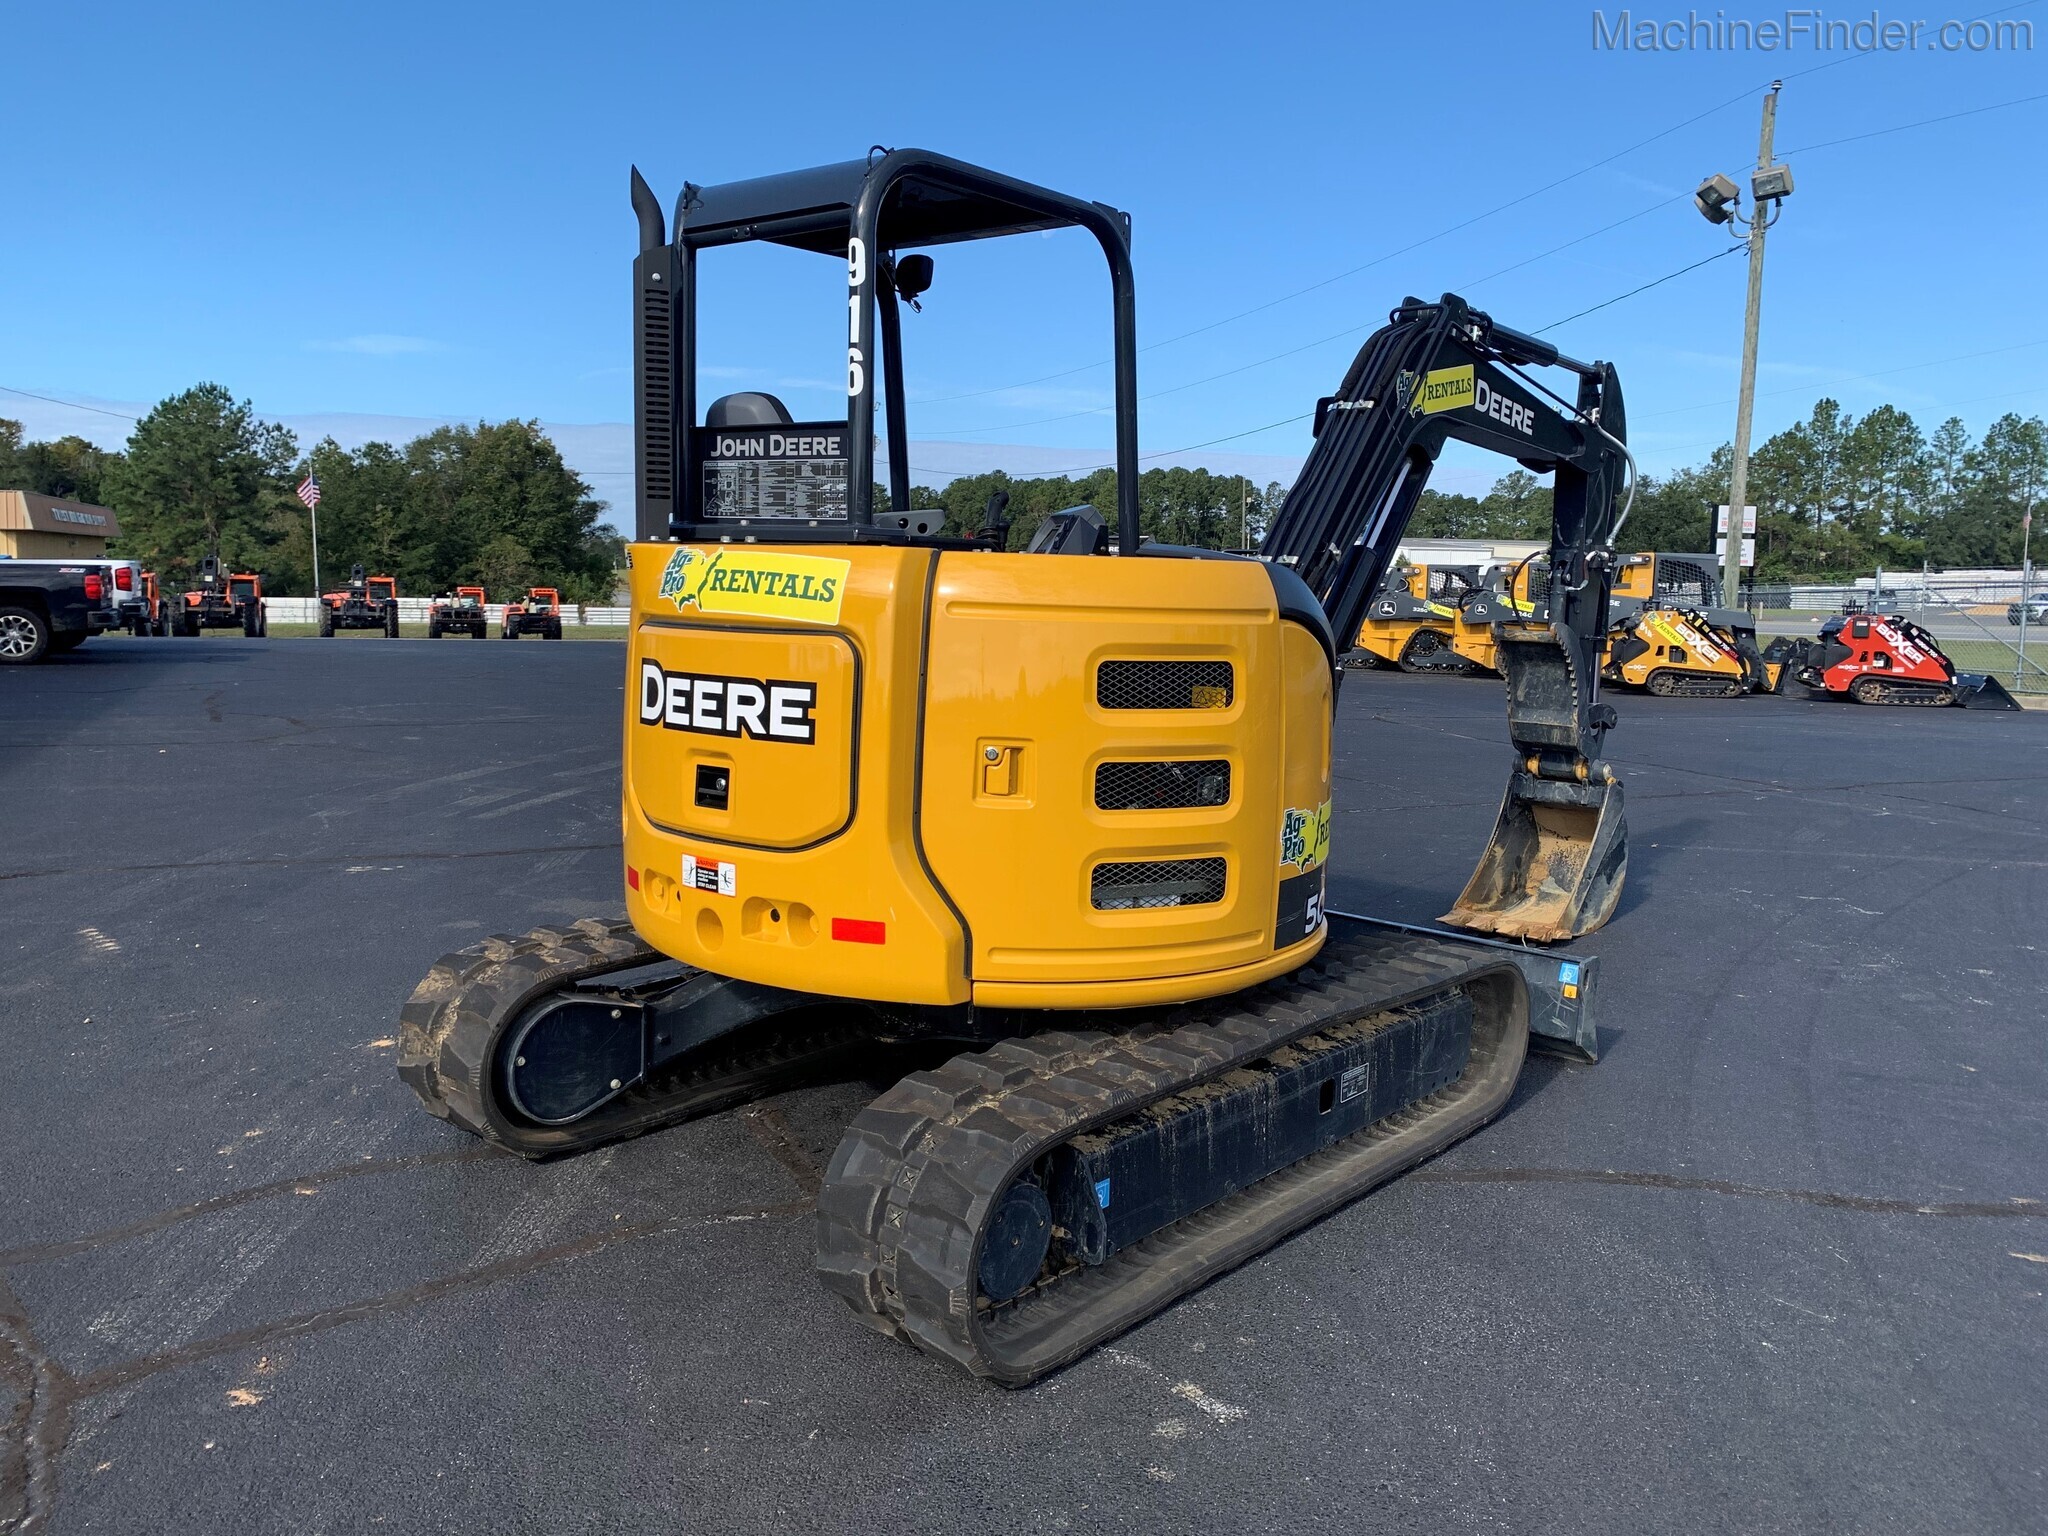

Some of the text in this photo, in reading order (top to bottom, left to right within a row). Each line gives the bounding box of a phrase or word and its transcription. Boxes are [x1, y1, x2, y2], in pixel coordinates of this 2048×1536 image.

[848, 237, 866, 397] 916
[1427, 377, 1473, 401] RENTALS
[1474, 379, 1535, 436] DEERE
[710, 434, 841, 458] JOHN DEERE
[666, 549, 693, 575] Ag-
[660, 570, 686, 595] Pro
[709, 568, 838, 603] RENTALS
[1659, 624, 1682, 645] RENTALS
[1674, 622, 1723, 663] BOXER
[1875, 623, 1925, 665] BOXER
[641, 663, 812, 740] DEERE
[1283, 812, 1306, 840] Ag-
[1282, 838, 1305, 862] Pro
